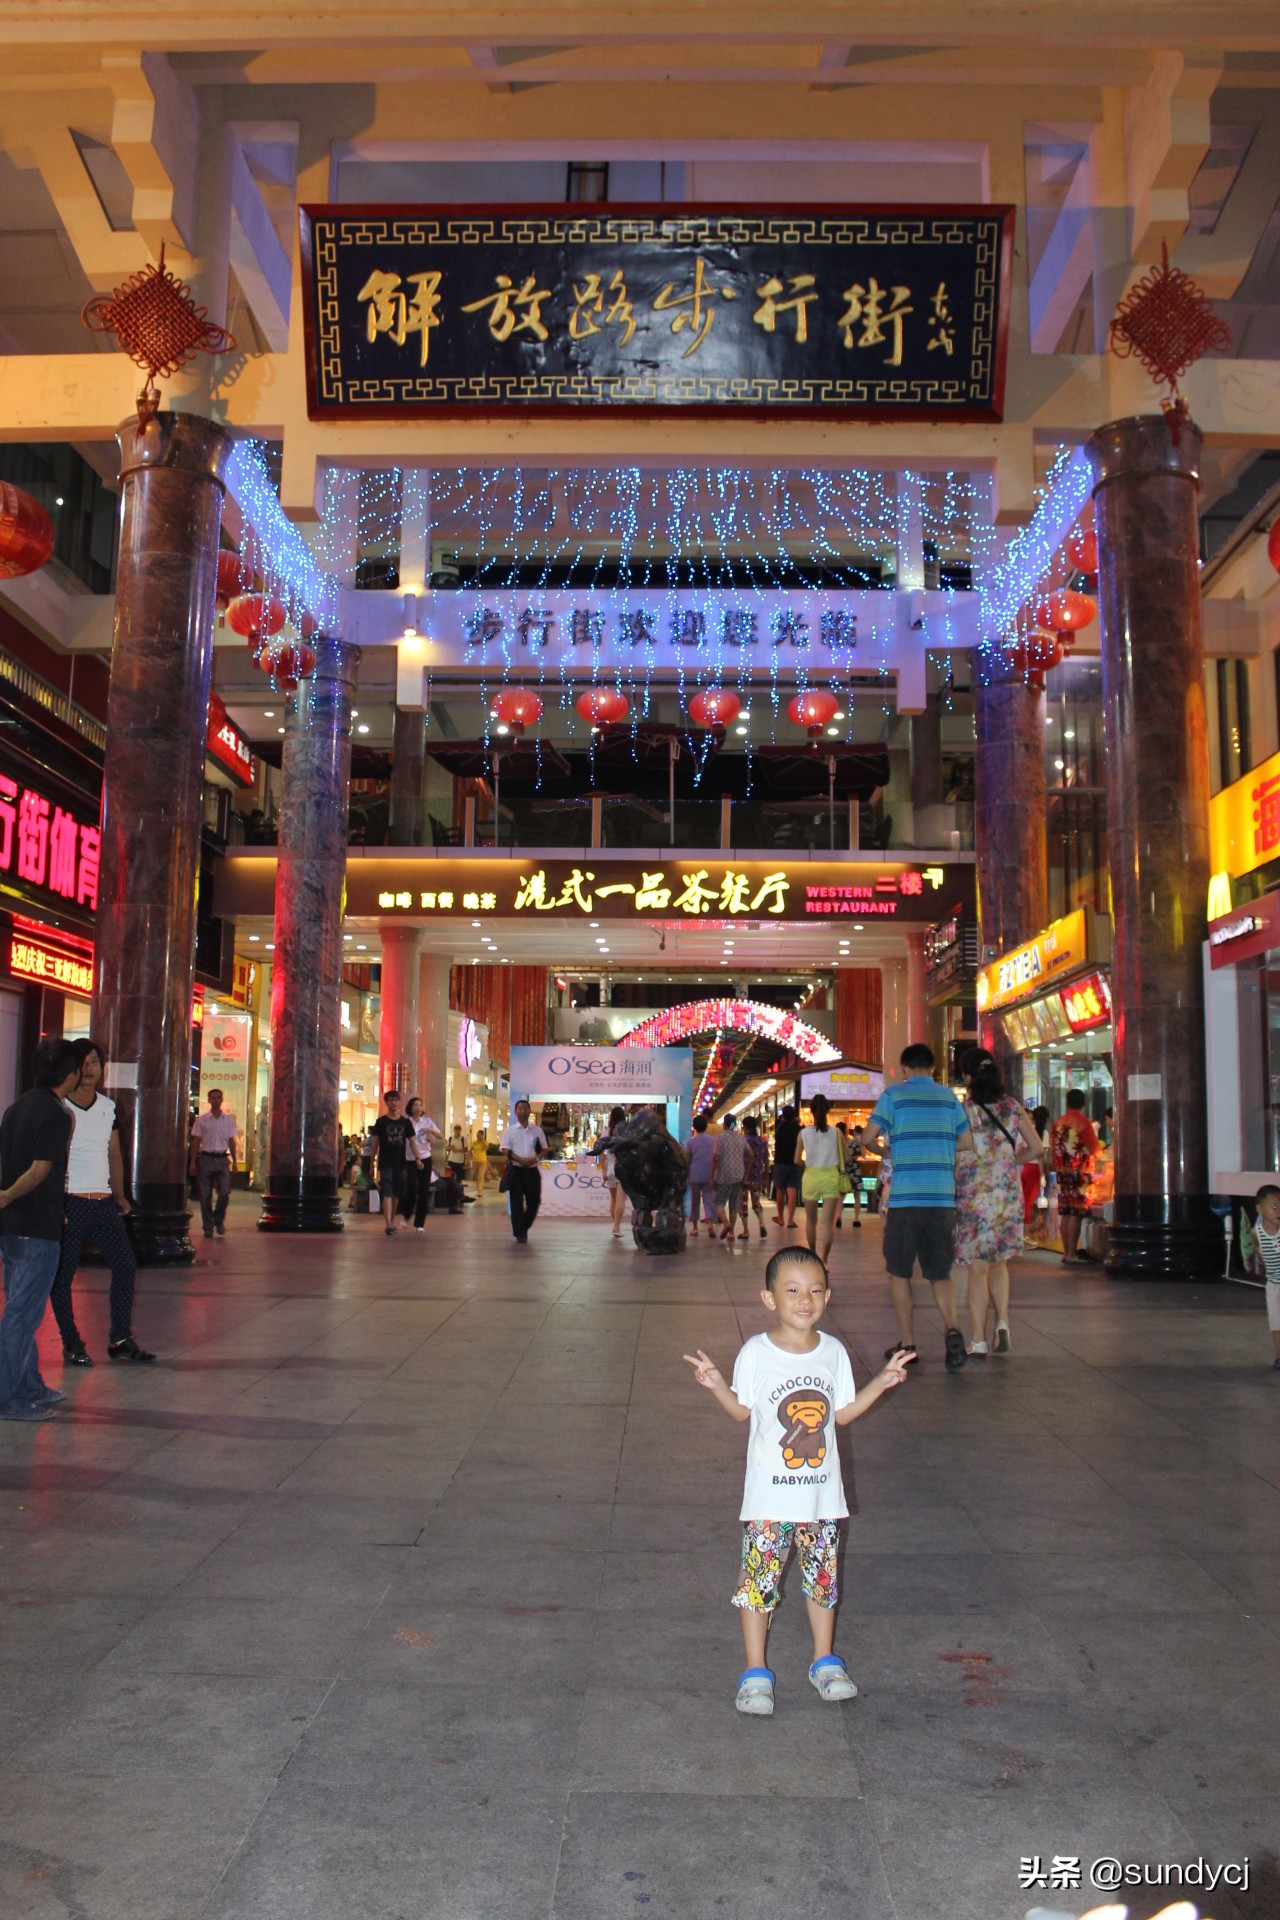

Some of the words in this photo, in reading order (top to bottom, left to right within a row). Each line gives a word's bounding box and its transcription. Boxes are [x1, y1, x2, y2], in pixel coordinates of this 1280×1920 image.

[357, 256, 914, 368] 解放路步行街
[466, 607, 858, 648] 步行街欢迎您光临
[806, 886, 873, 898] WESTERN
[875, 871, 922, 895] 二楼
[805, 902, 897, 914] RESTAURANT
[549, 1056, 616, 1076] O'sea
[619, 1059, 652, 1076] 海润
[772, 1474, 828, 1485] BABYMILO
